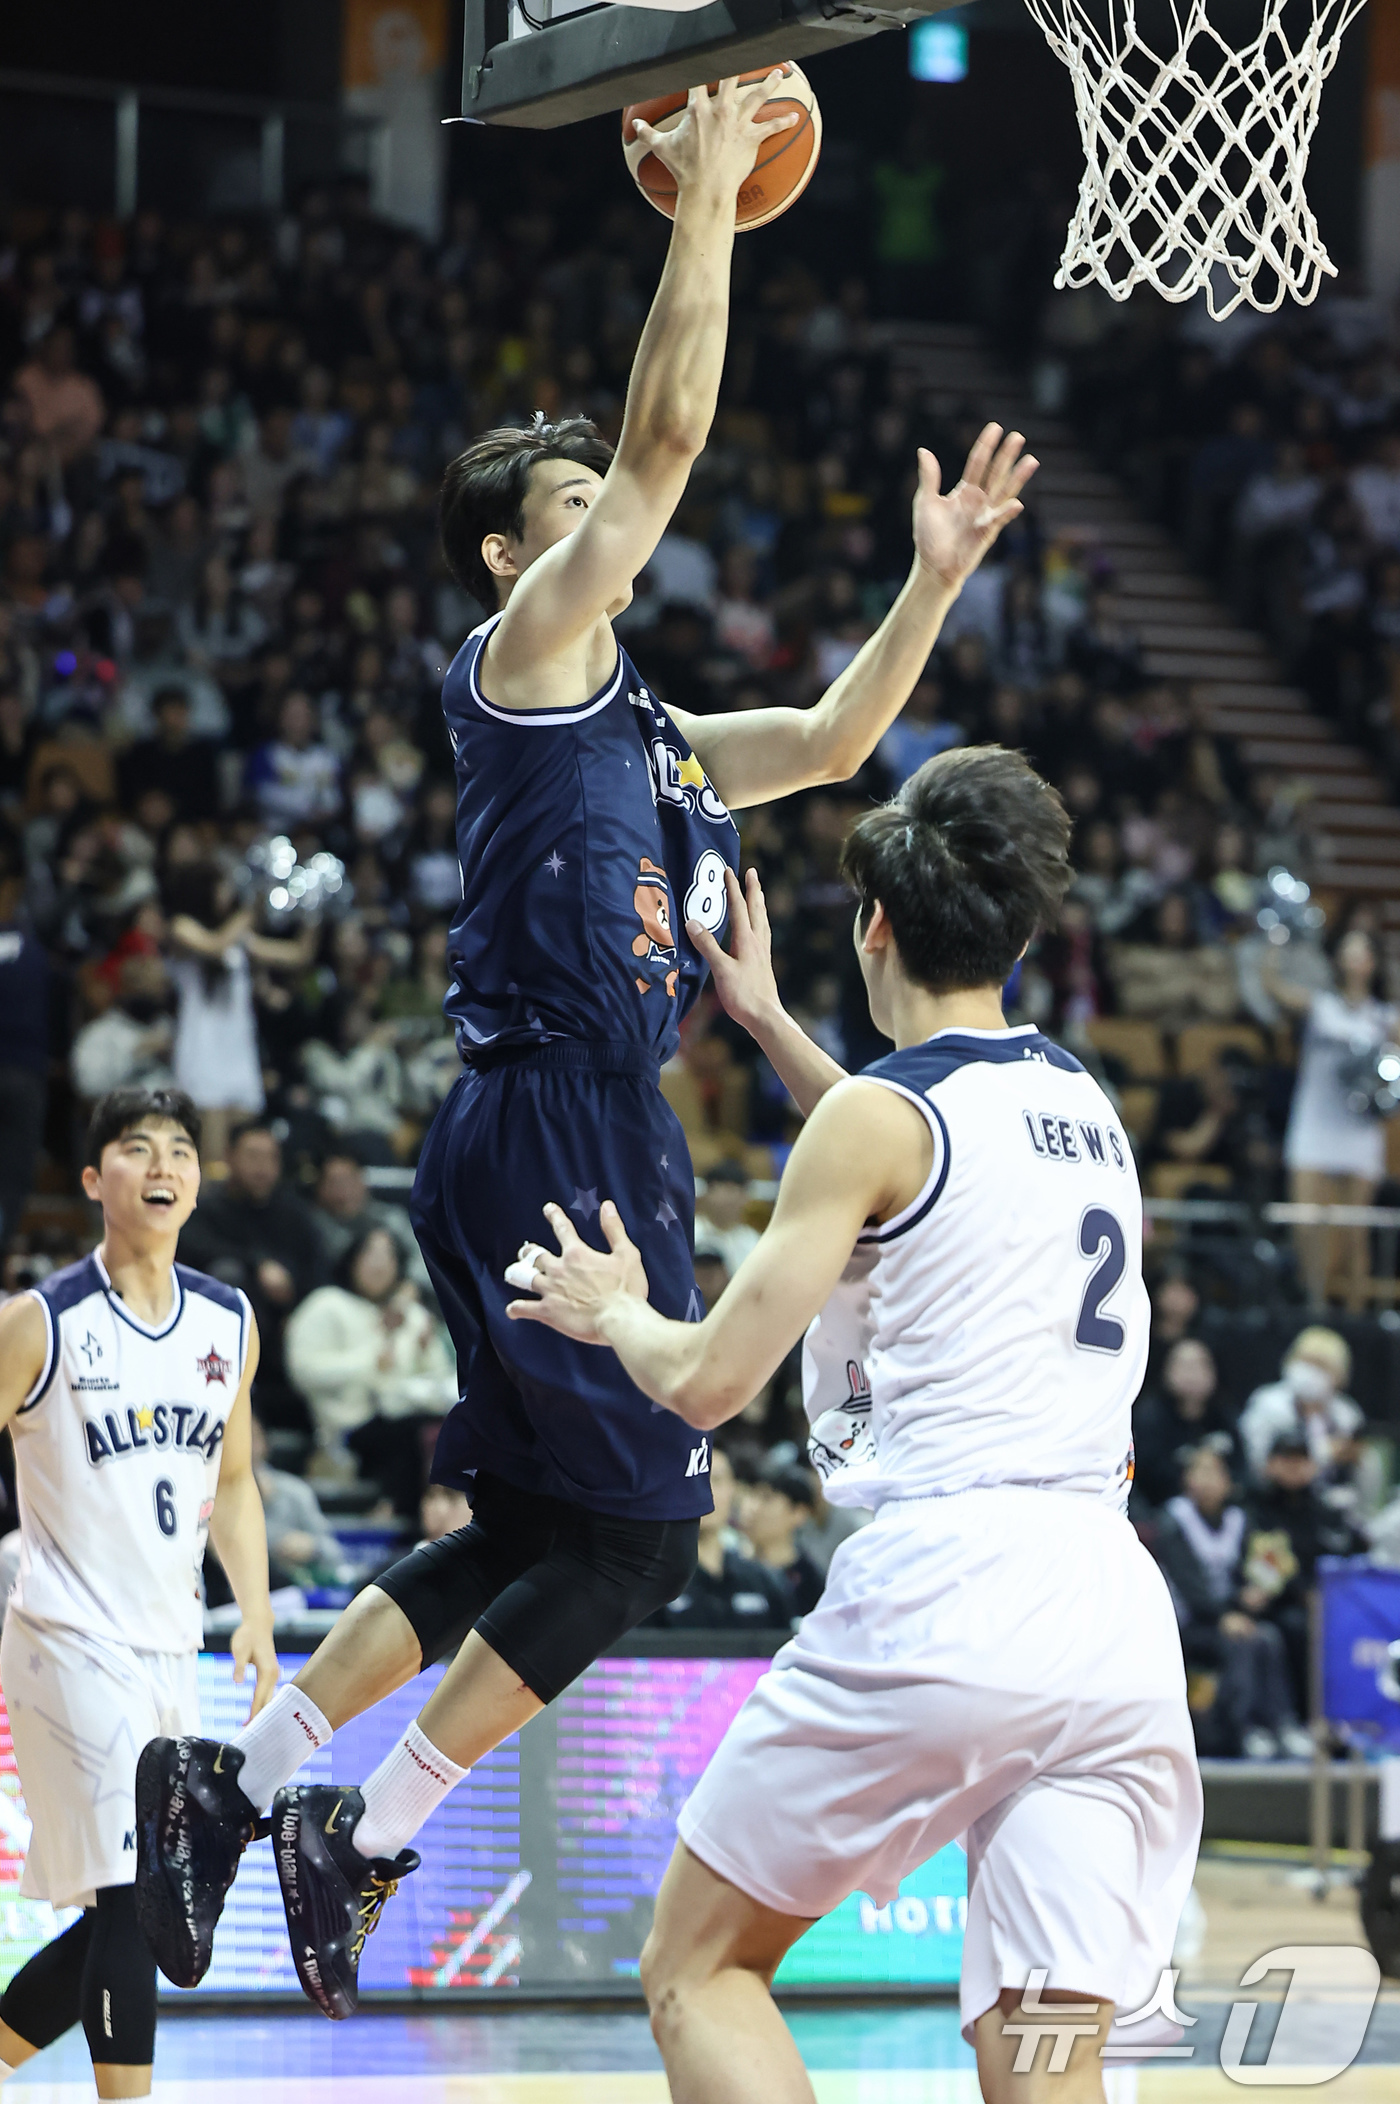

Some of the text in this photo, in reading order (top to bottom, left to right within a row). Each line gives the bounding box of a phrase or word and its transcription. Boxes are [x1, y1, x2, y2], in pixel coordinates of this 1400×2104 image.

[683, 849, 727, 934] 8
[1024, 1111, 1126, 1170] LEE W S
[1074, 1204, 1125, 1354] 2
[153, 1477, 178, 1539] 6
[404, 1740, 448, 1786] knights
